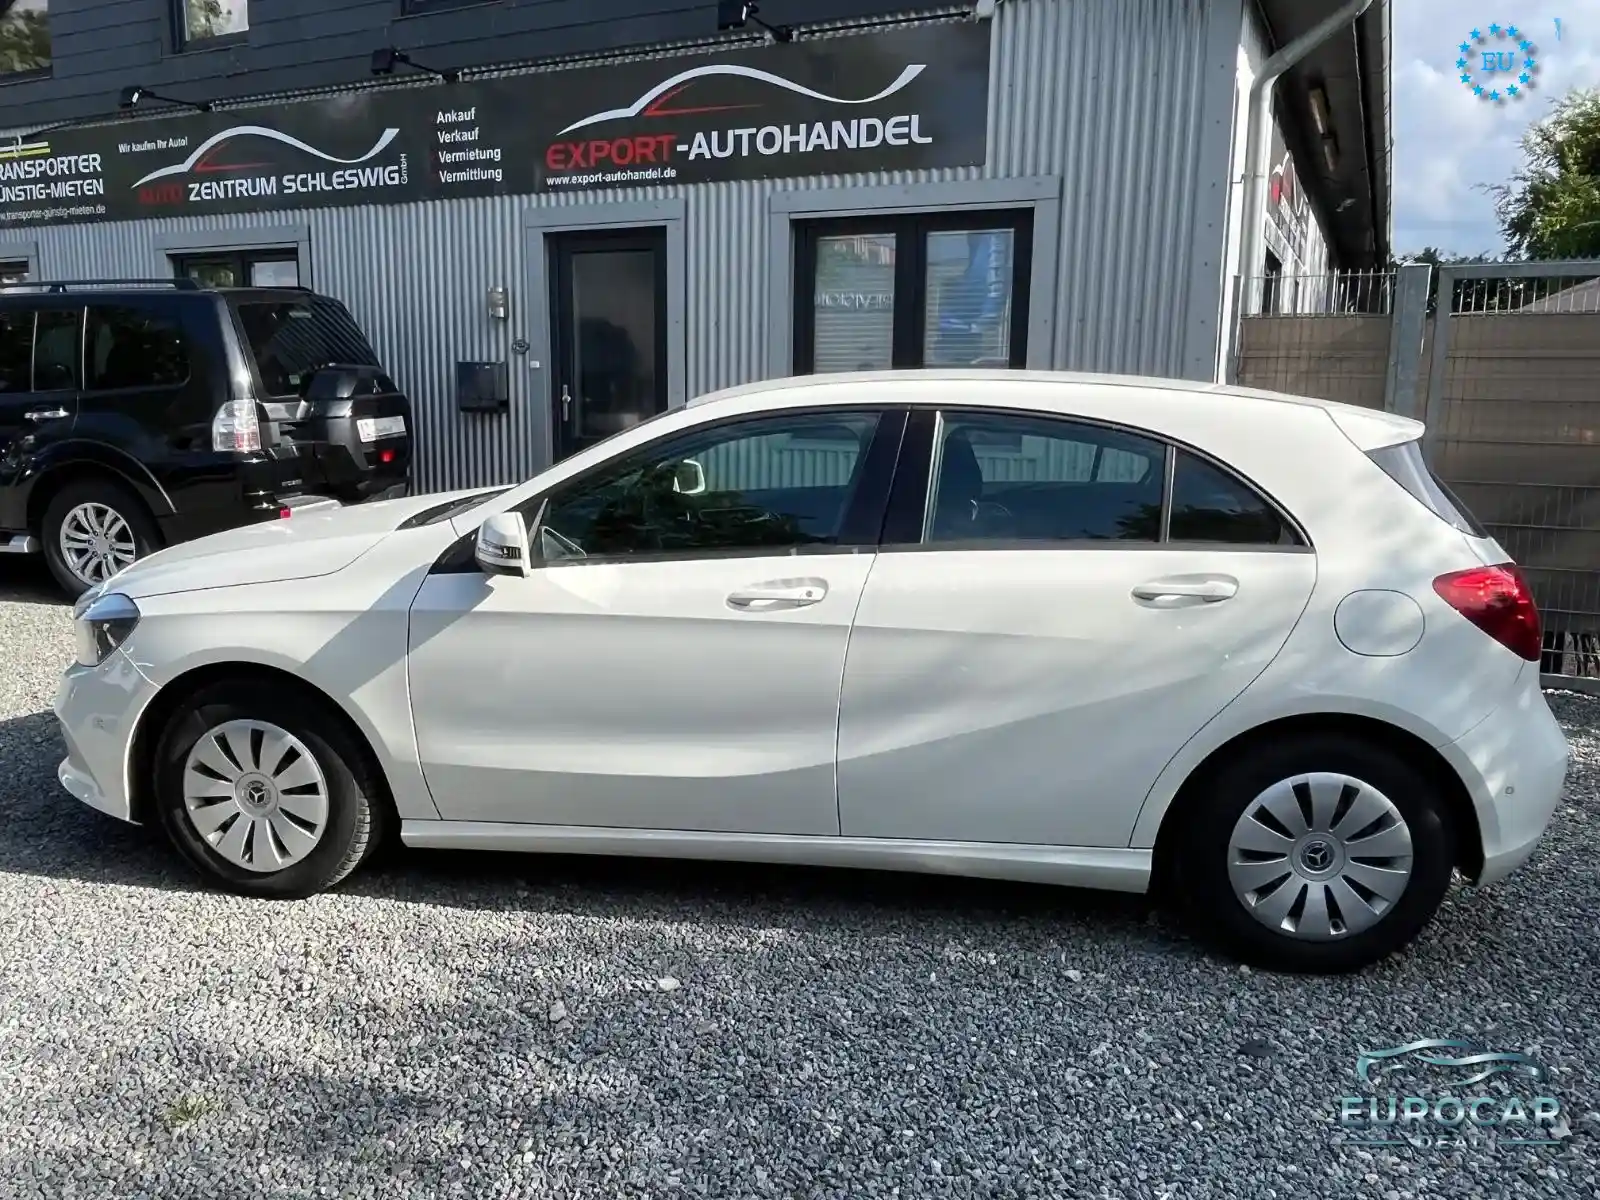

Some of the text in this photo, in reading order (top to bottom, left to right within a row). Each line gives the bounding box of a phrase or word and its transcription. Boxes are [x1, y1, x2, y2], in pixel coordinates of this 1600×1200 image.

[436, 107, 477, 124] Ankauf
[437, 127, 480, 143] Verkauf
[546, 115, 932, 169] EXPORT-AUTOHANDEL
[118, 136, 188, 153] Wir kaufen Ihr Auto!
[438, 148, 501, 163] Vermietung
[188, 177, 277, 201] ZENTRUM
[283, 166, 399, 194] SCHLESWIG
[439, 168, 503, 183] Vermittlung
[547, 167, 677, 185] www.export-autohandel.de
